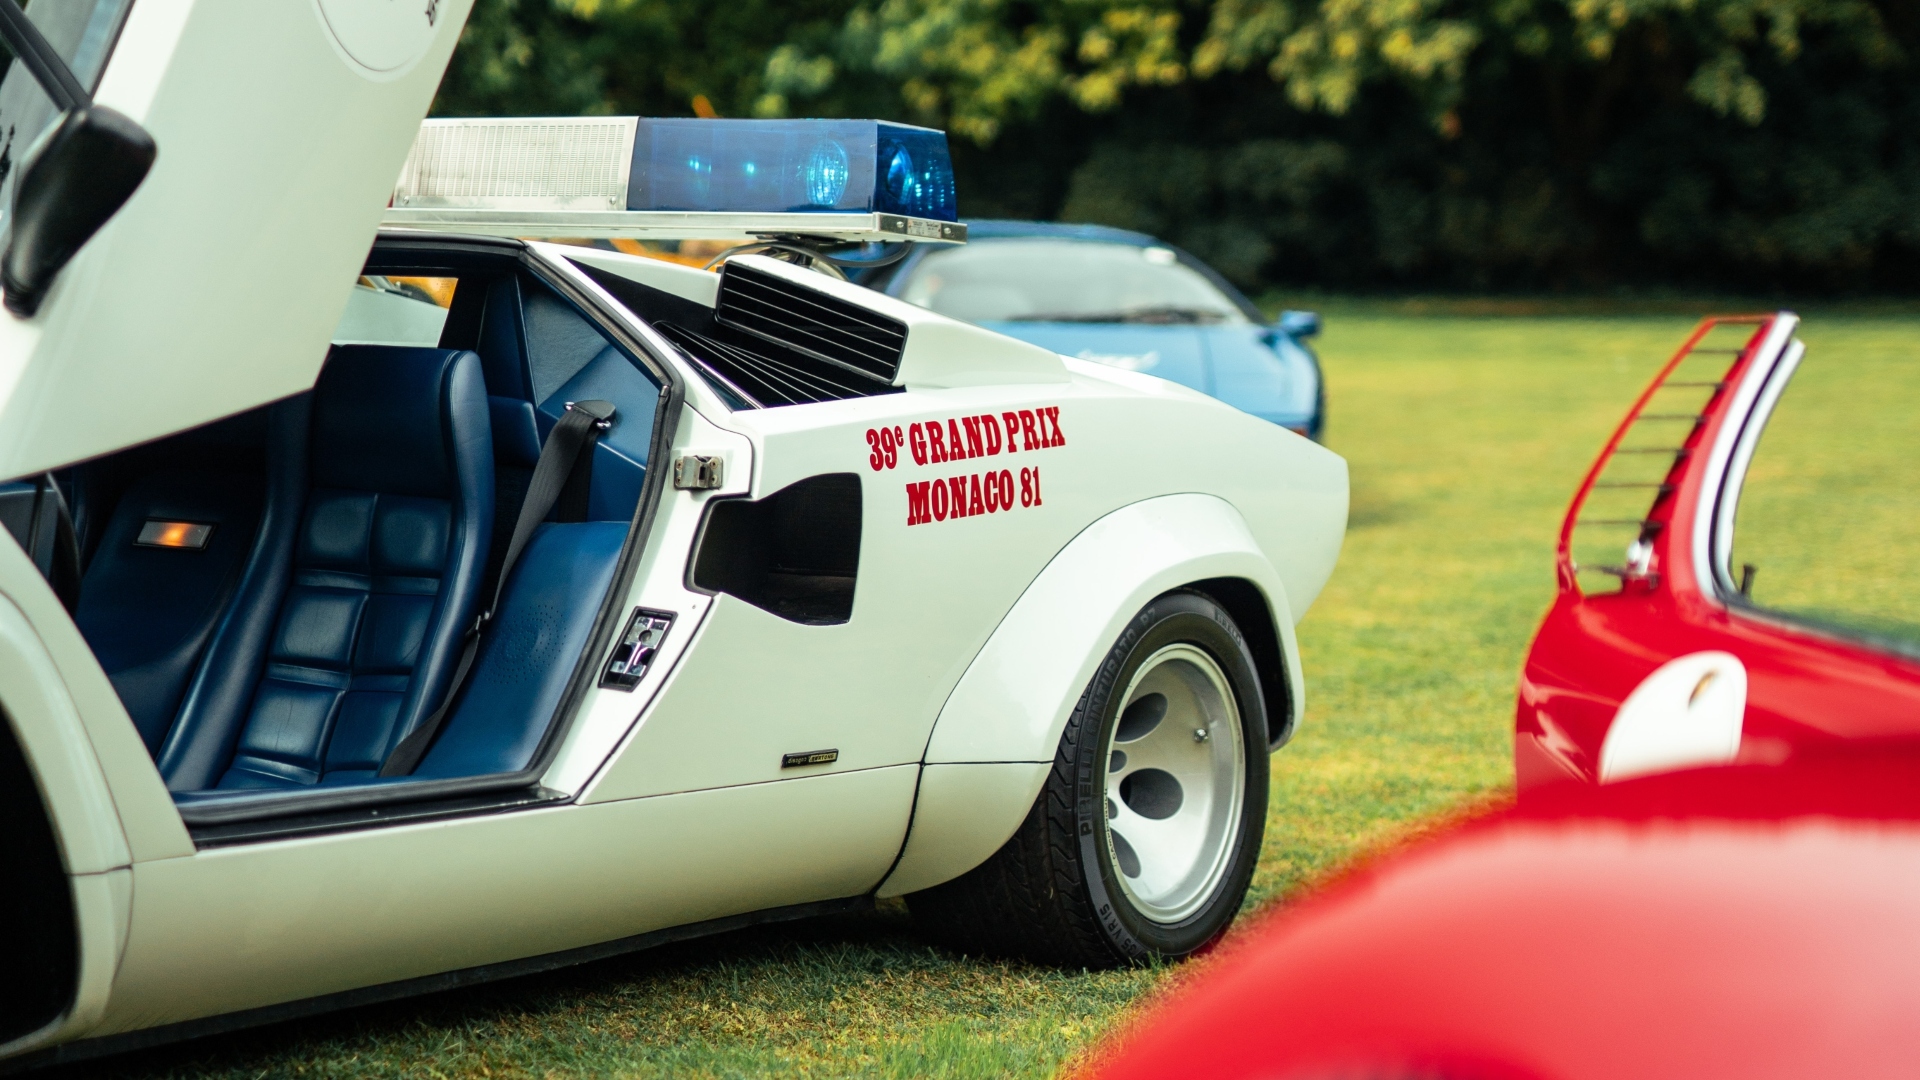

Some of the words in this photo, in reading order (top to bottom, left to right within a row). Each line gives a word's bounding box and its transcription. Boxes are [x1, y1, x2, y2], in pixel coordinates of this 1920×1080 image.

[909, 414, 1002, 466] GRAND
[1002, 406, 1066, 453] PRIX
[906, 469, 1015, 526] MONACO
[1020, 466, 1042, 508] 81
[1079, 747, 1094, 836] PIRELLI
